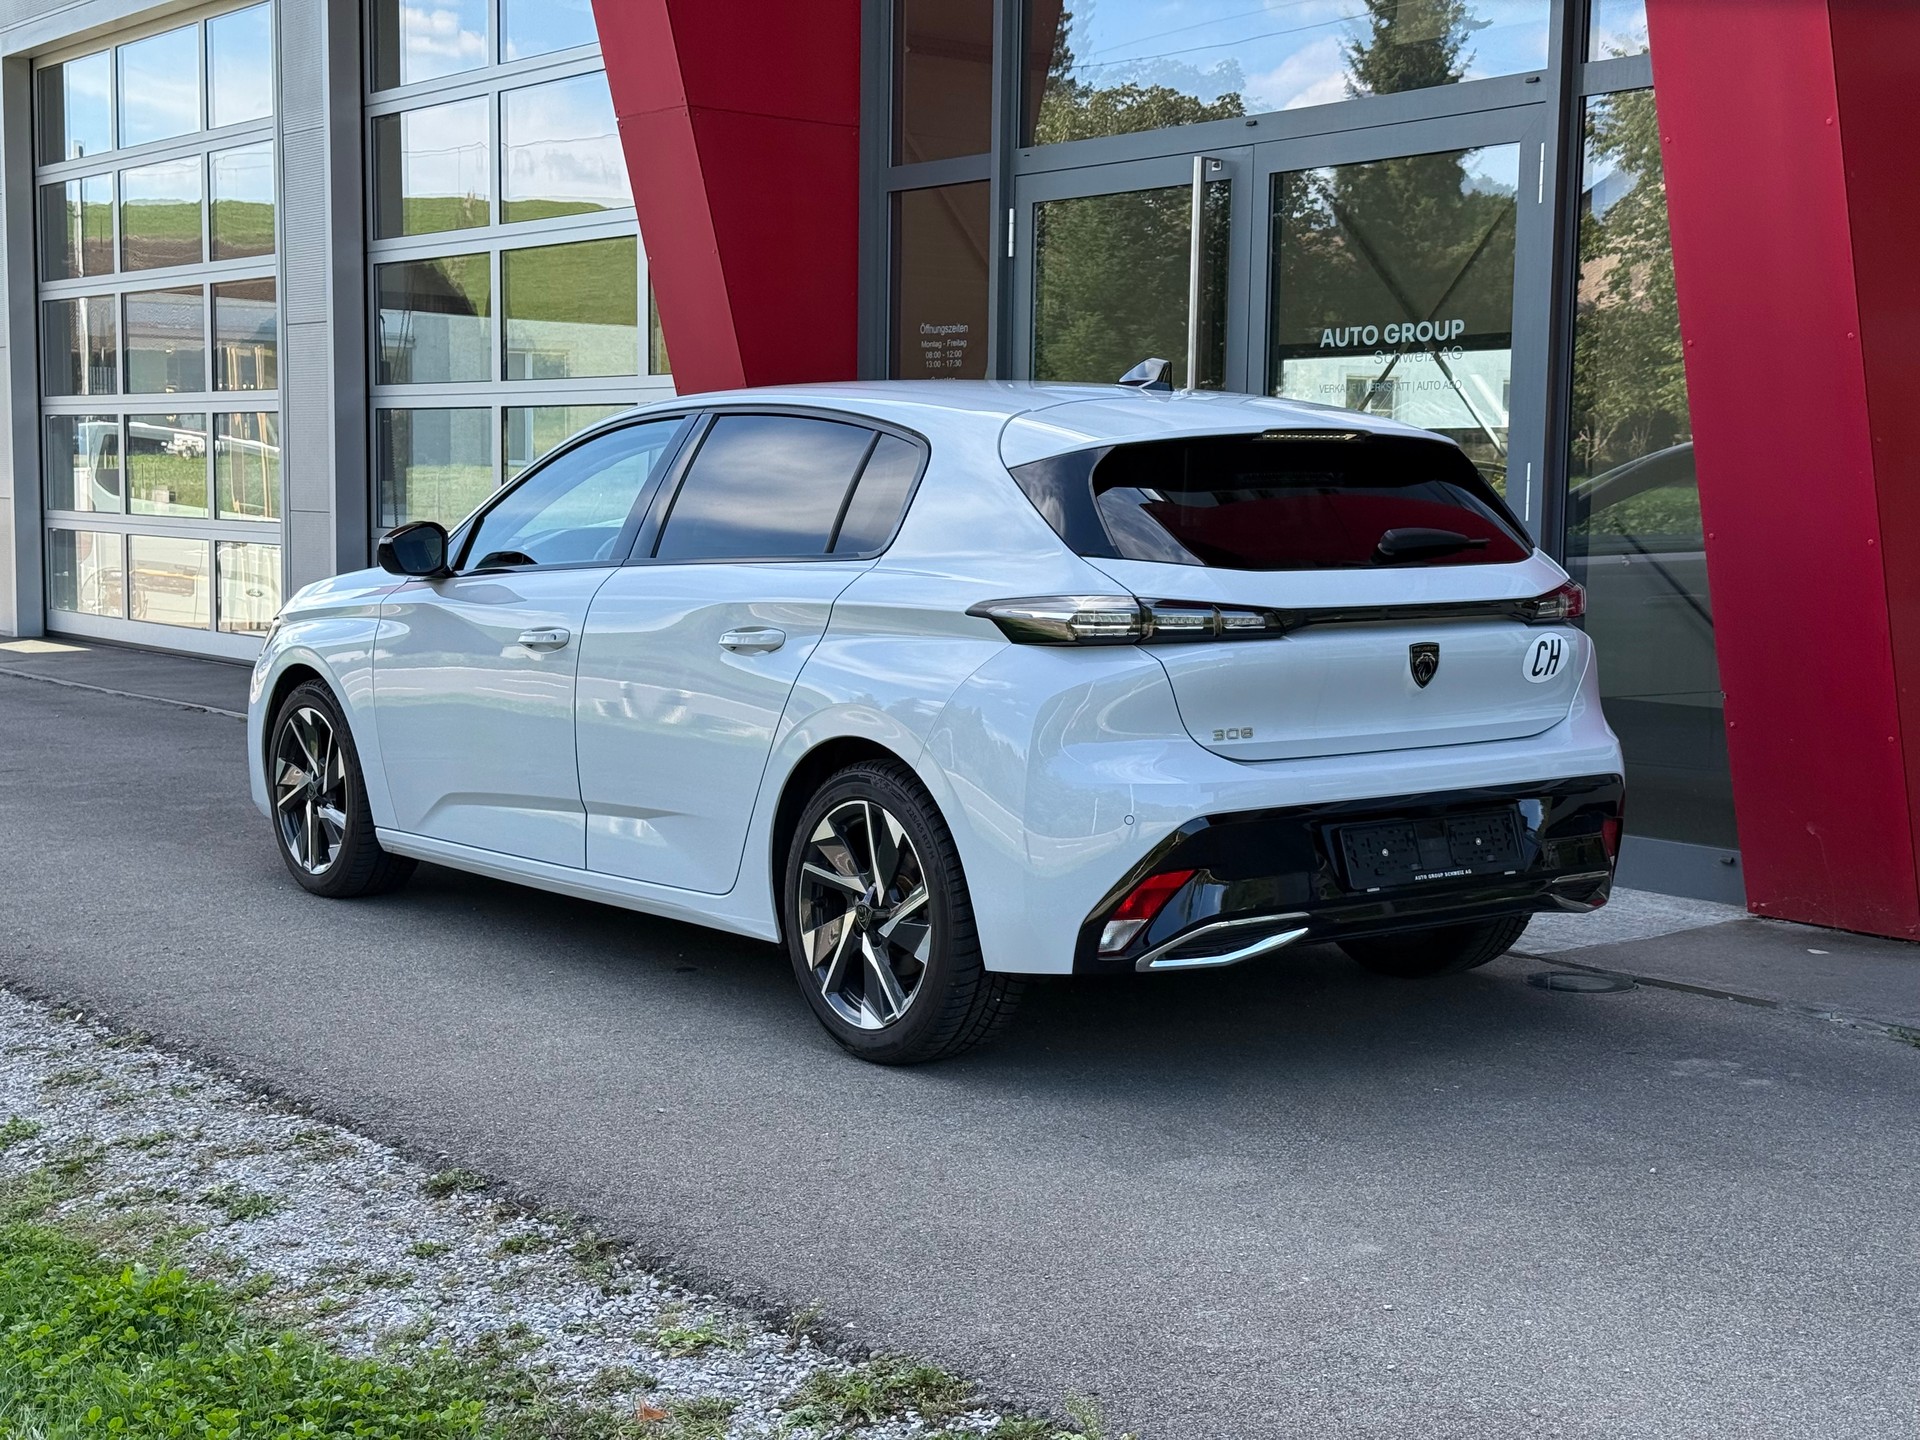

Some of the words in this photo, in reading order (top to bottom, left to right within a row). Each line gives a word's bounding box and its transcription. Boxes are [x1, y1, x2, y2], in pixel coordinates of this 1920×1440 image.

[920, 323, 969, 335] Öffnungszeiten
[1320, 325, 1379, 348] AUTO
[1383, 319, 1465, 344] GROUP
[921, 341, 942, 349] Montag
[946, 339, 967, 348] Freitag
[926, 351, 941, 359] 08:00
[946, 350, 962, 358] 12:00
[1374, 347, 1435, 365] Schweiz
[1439, 345, 1464, 361] AG
[926, 360, 941, 368] 13:00
[1361, 381, 1411, 393] WERKSATT
[1416, 380, 1441, 391] AUTO
[1532, 639, 1561, 676] CH
[1212, 727, 1254, 741] 308
